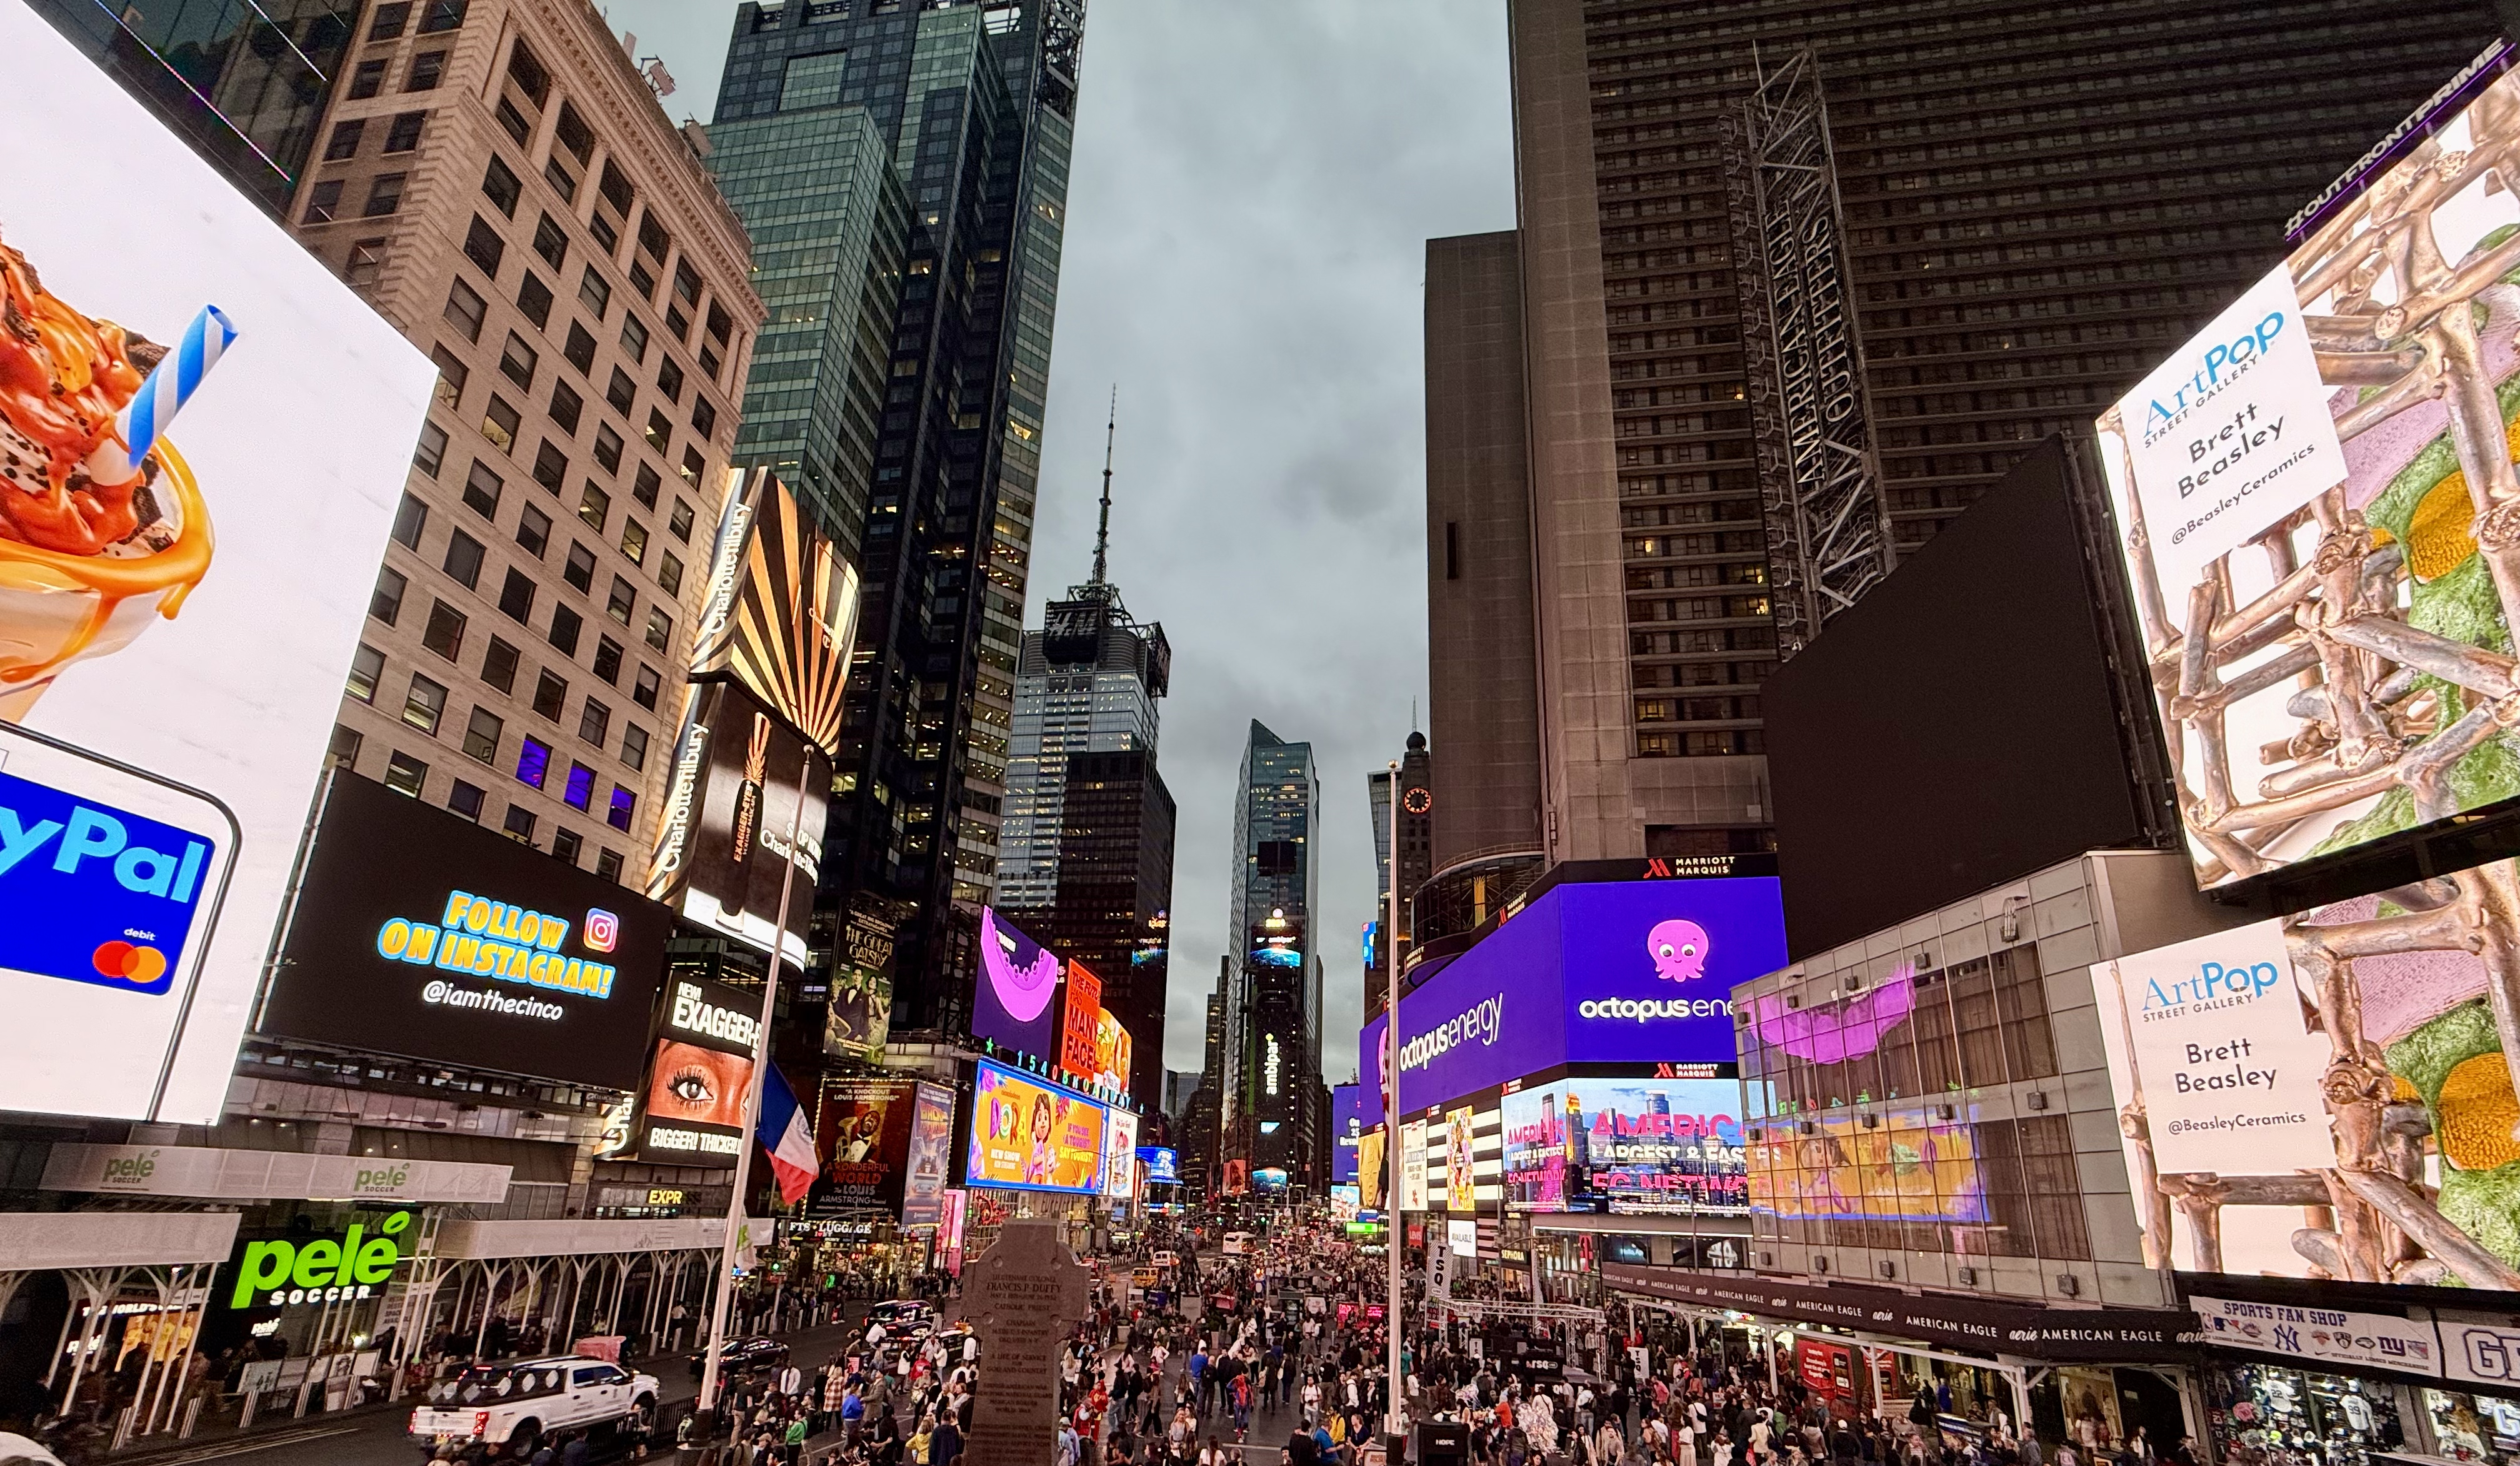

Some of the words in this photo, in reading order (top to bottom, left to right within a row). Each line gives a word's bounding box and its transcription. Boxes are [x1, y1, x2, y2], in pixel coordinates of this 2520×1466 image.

[2284, 38, 2505, 236] #OUTFRONTPRIME
[2144, 310, 2284, 438] ArtPop
[2145, 409, 2189, 448] STREET
[2196, 354, 2258, 408] GALLERY
[2189, 403, 2258, 463] Brett
[2178, 416, 2284, 499] Beasley
[2172, 444, 2315, 544] @BeasleyCeramics
[786, 821, 809, 846] SOP
[1675, 856, 1735, 866] MARRIOTT
[1676, 865, 1729, 875] MARQUIS
[444, 891, 568, 951] FOLLOW
[124, 927, 156, 941] debit
[846, 925, 863, 944] THE
[864, 935, 894, 956] GREAT
[379, 918, 439, 963] ON
[436, 931, 614, 998] INSTAGRAM!
[849, 944, 888, 966] GATSBY
[678, 982, 702, 1002] NEW!
[1072, 971, 1084, 990] THE
[2141, 961, 2278, 1012] ArtPop
[423, 981, 562, 1020] @iamthecinco
[2143, 1007, 2186, 1022] STREET
[2193, 993, 2252, 1013] GALLERY
[1066, 1033, 1096, 1071] FACE
[2186, 1038, 2251, 1064] Brett
[1266, 1040, 1279, 1095] ambipar
[2175, 1064, 2276, 1093] Beasley
[990, 1098, 1026, 1146] DORA
[2168, 1112, 2306, 1135] @BeasleyCeramics
[650, 1128, 698, 1151] BIGGER!
[1687, 1146, 1701, 1158] &
[832, 1172, 881, 1184] WORLD
[834, 1163, 890, 1172] WONDERFUL
[819, 1195, 871, 1204] ARMSTRONG
[844, 1185, 875, 1195] LOUIS
[231, 1211, 409, 1310] pelé
[1501, 1250, 1524, 1260] SEPHORA
[270, 1285, 371, 1306] SOCCER
[987, 1282, 1022, 1292] FRANCIS
[1032, 1284, 1062, 1293] DUFFY
[1622, 1276, 1634, 1284] EAGLE
[1651, 1281, 1674, 1291] AMERICAN
[1675, 1284, 1690, 1293] EAGLE
[1714, 1290, 1743, 1301] AMERICAN
[1745, 1293, 1764, 1304] EAGLE
[1771, 1297, 1787, 1307] aerie
[1796, 1300, 1834, 1313] AMERICAN
[1838, 1305, 1862, 1317] EAGLE
[1872, 1309, 1893, 1322] aerie
[1906, 1315, 1958, 1332] AMERICAN
[1963, 1323, 1998, 1338] EAGLE
[2009, 1327, 2038, 1342] aerie
[2041, 1329, 2114, 1342] AMERICAN
[2121, 1330, 2162, 1342] EAGLE
[2176, 1329, 2206, 1343] aerie
[2224, 1302, 2273, 1320] SPORTS
[2277, 1307, 2306, 1323] FAN
[2309, 1310, 2347, 1327] SHOP
[2271, 1389, 2284, 1399] 22
[2348, 1405, 2361, 1415] 99
